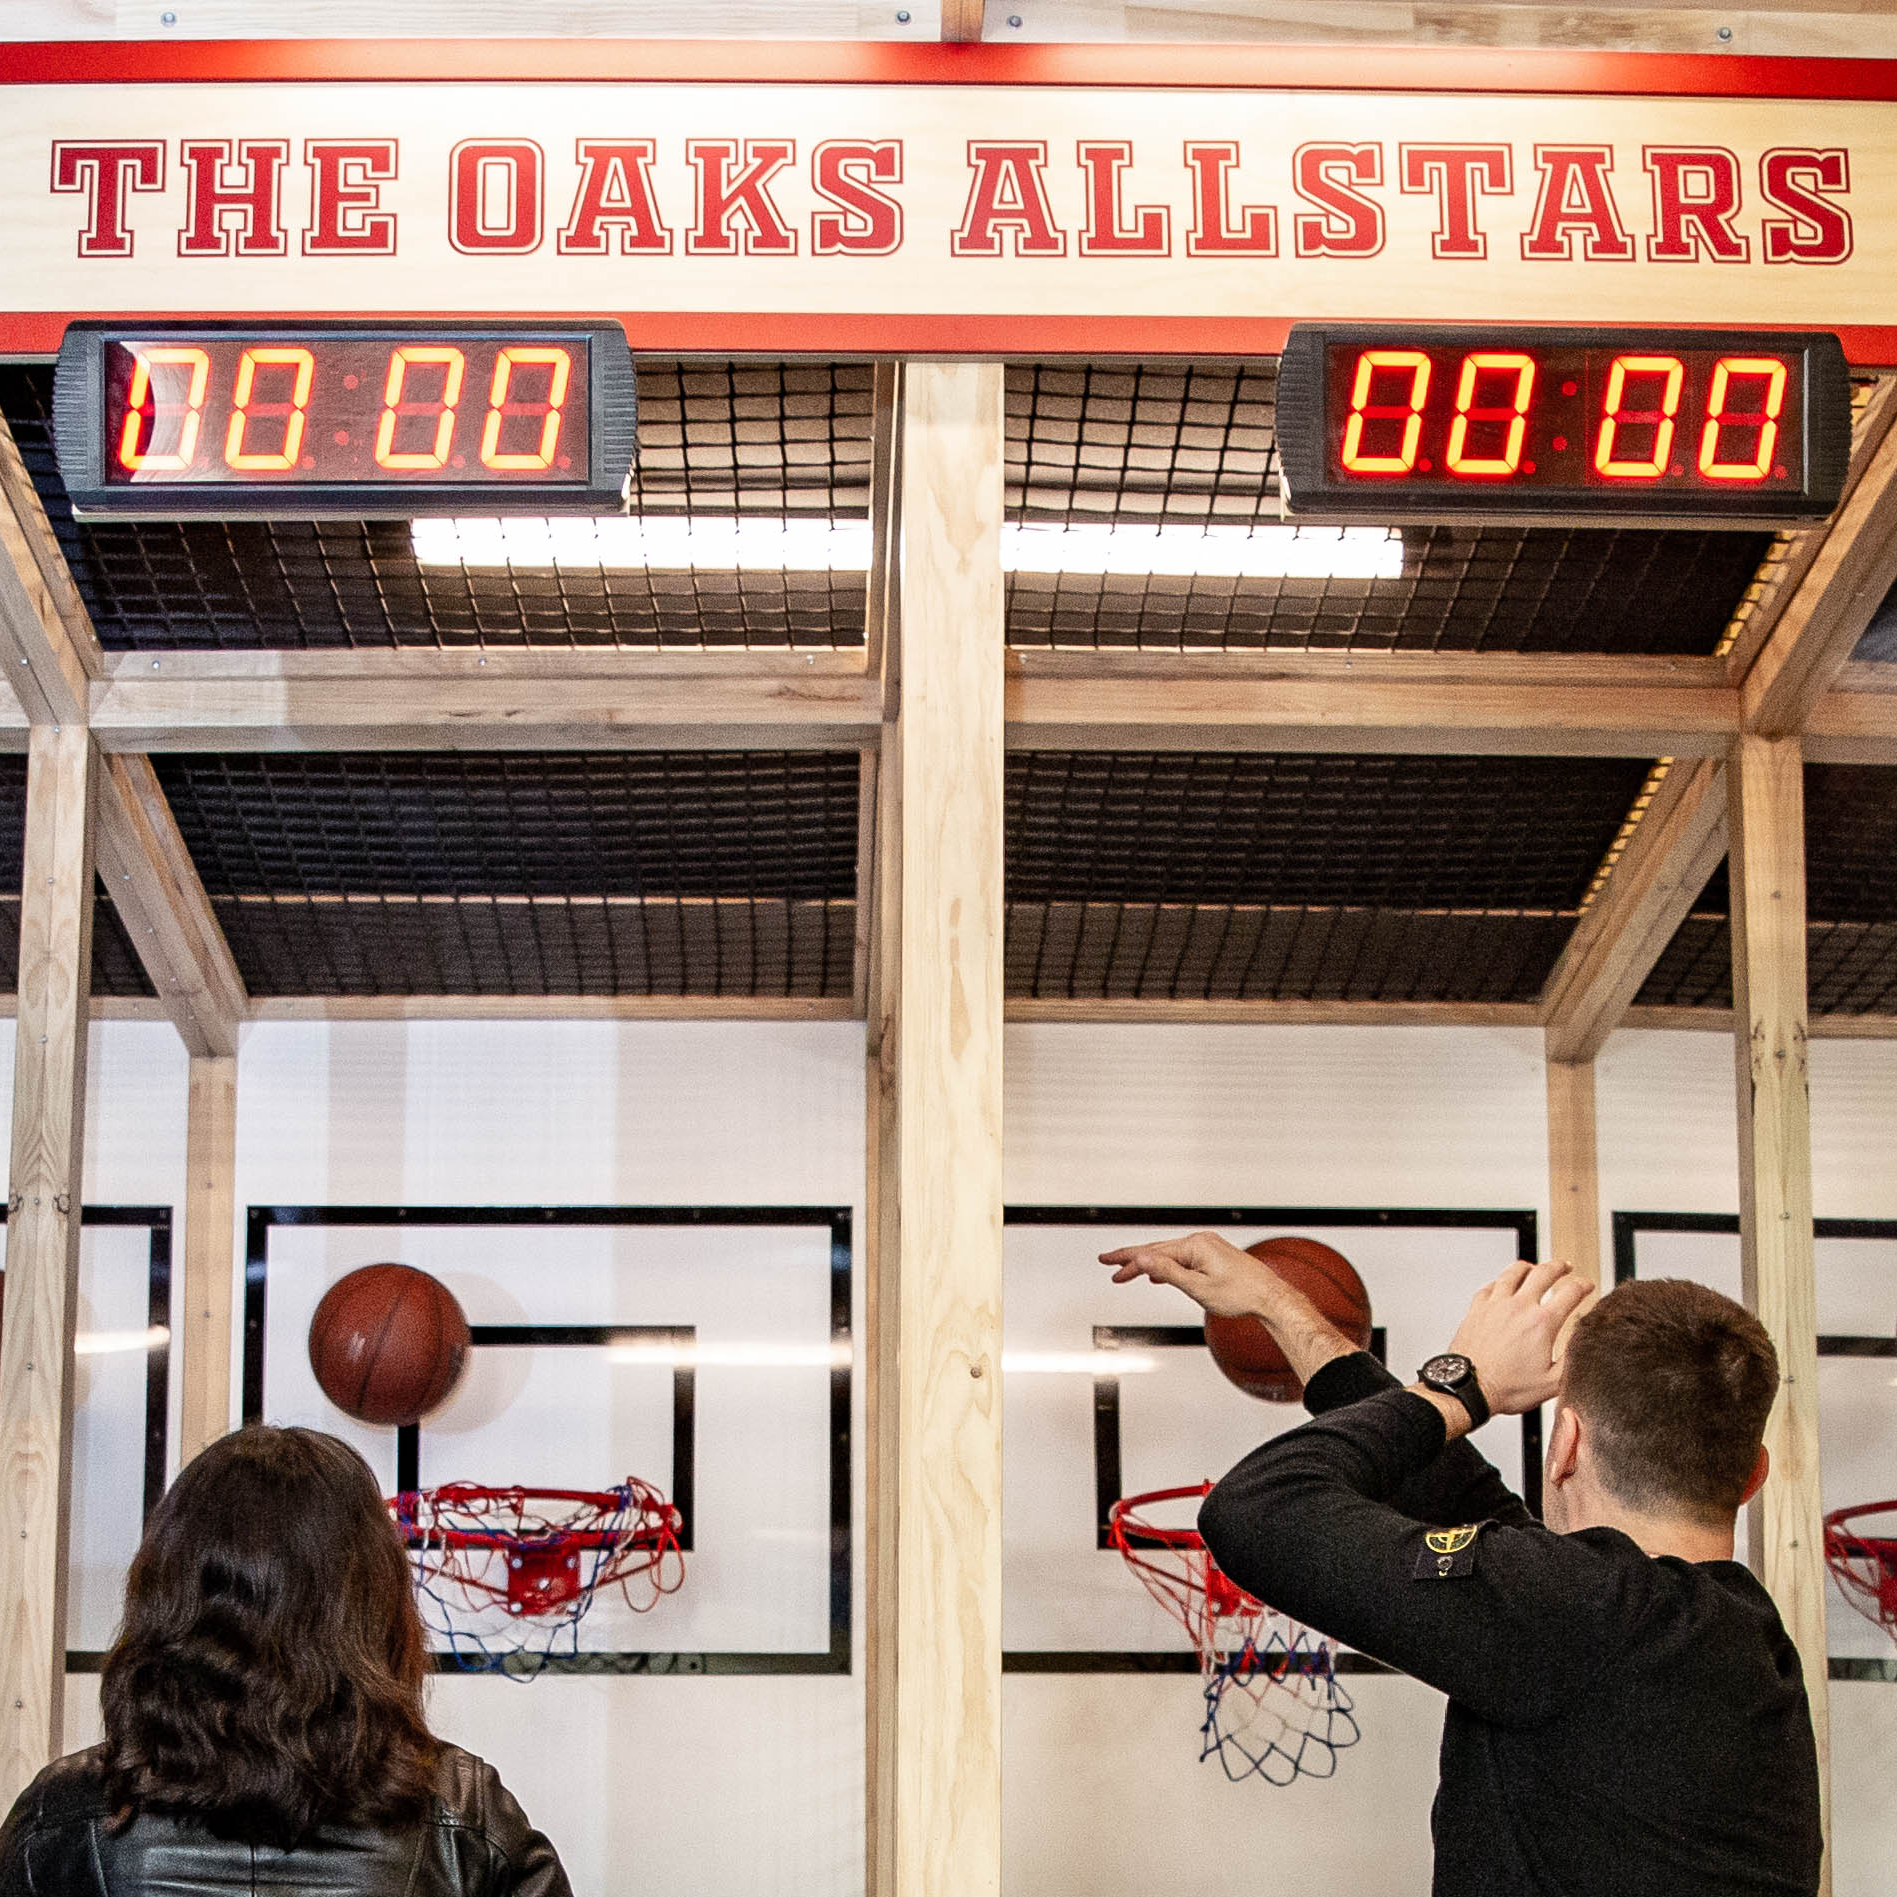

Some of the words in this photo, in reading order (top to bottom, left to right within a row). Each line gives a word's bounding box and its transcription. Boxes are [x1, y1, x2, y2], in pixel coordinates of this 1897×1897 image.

[50, 138, 399, 258] THE
[447, 137, 904, 258] OAKS
[950, 139, 1854, 265] ALLSTARS
